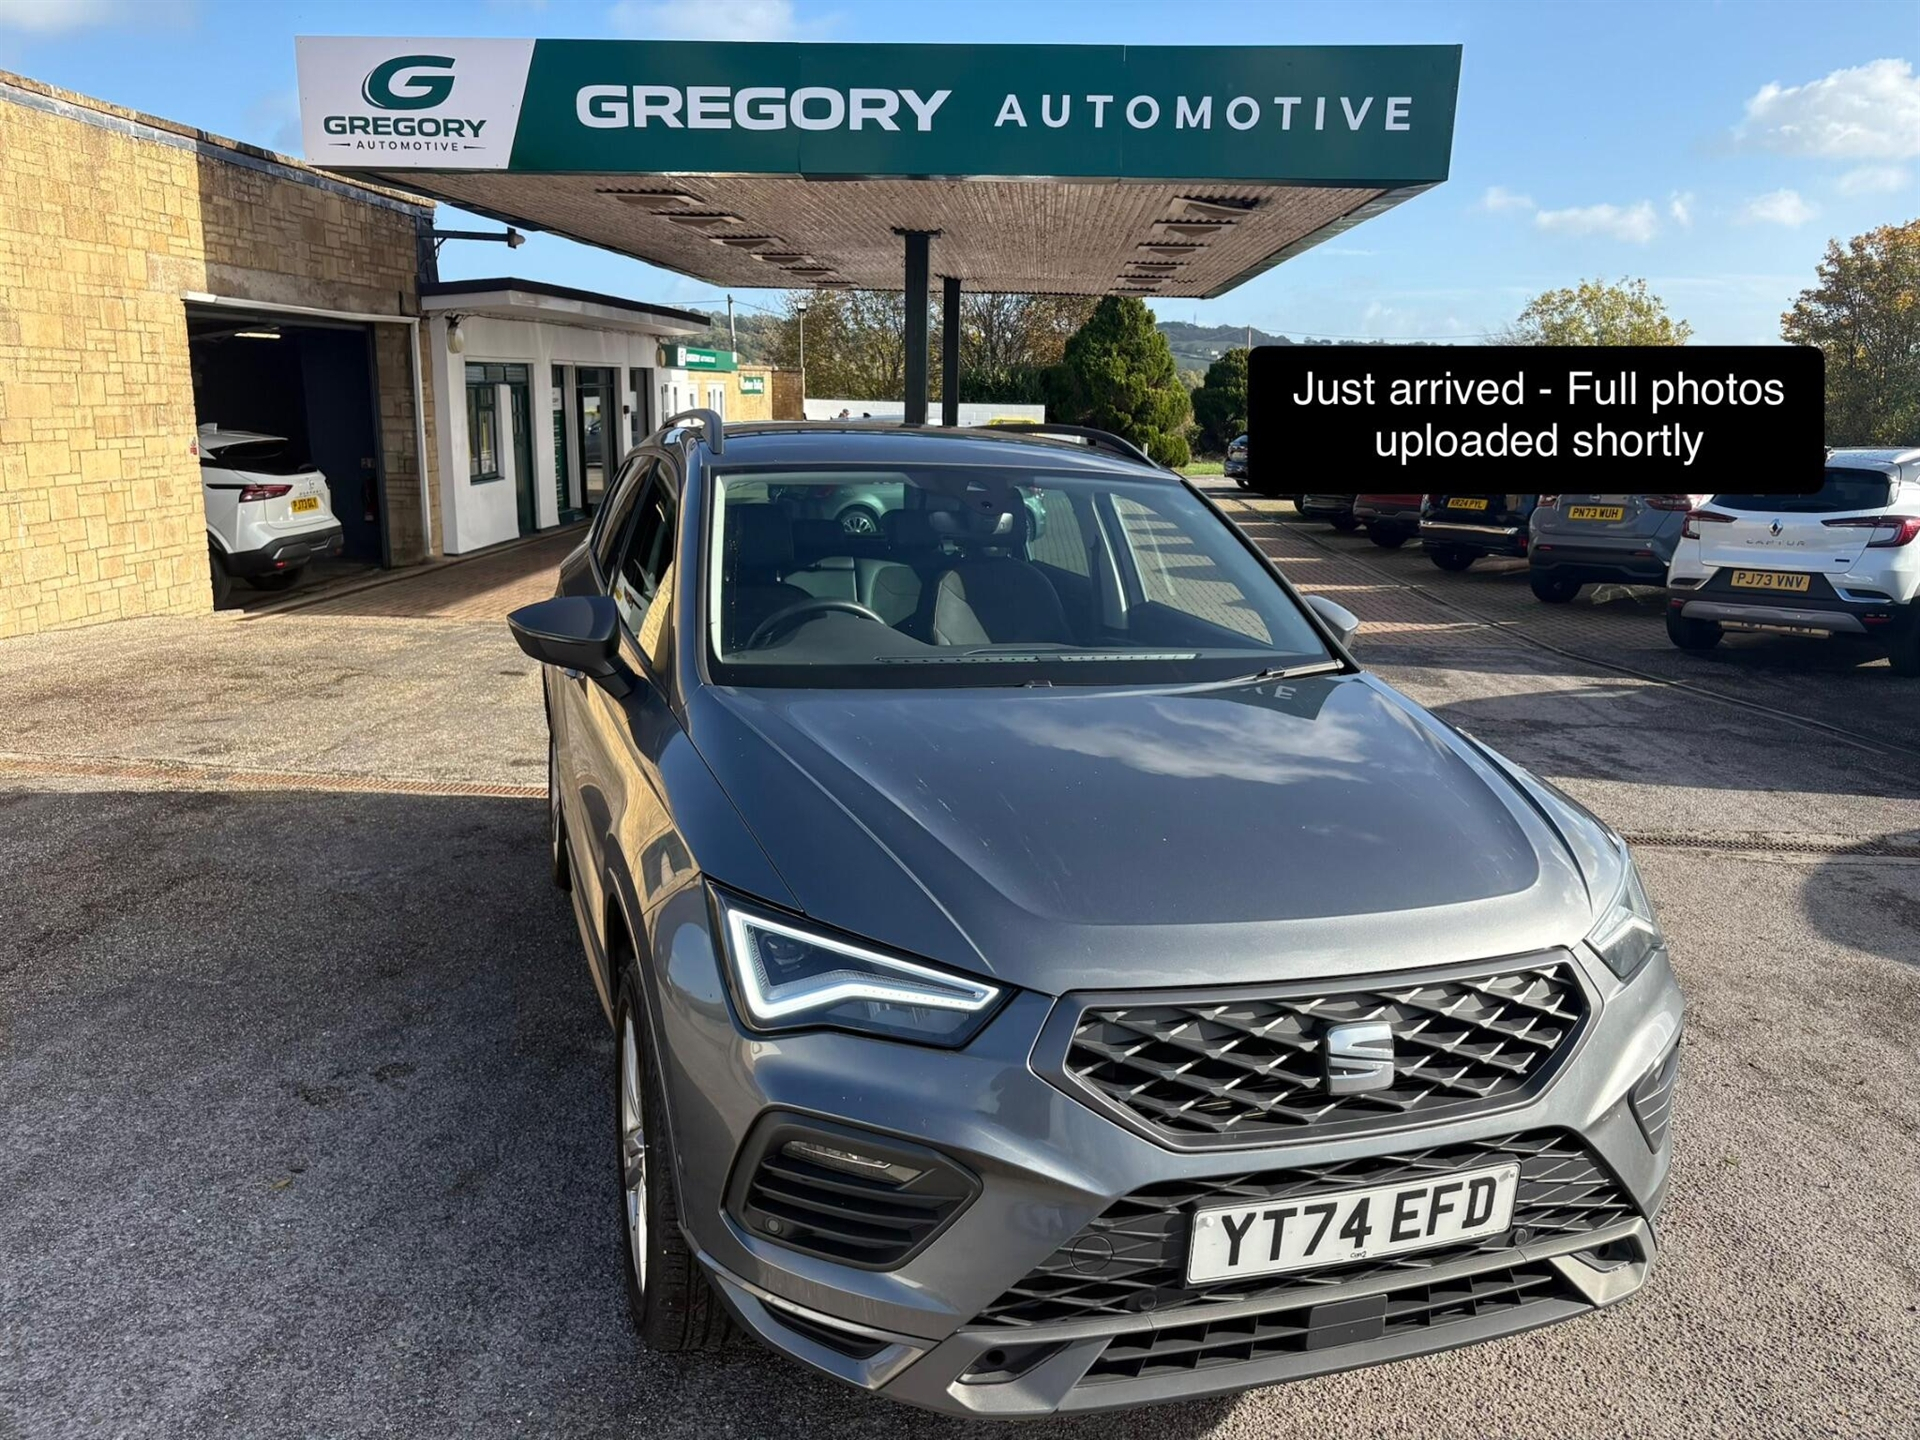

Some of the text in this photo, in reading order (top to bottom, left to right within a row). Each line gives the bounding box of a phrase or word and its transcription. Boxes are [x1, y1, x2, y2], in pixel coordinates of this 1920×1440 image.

[576, 84, 1412, 131] GREGORY AUTOMOTIVE
[323, 115, 487, 138] GREGORY
[356, 140, 459, 152] AUTOMOTIVE
[1572, 507, 1619, 519] PN73 WUH
[1736, 572, 1805, 588] PJ73 VNV
[1220, 1175, 1497, 1267] YT74 EFD
